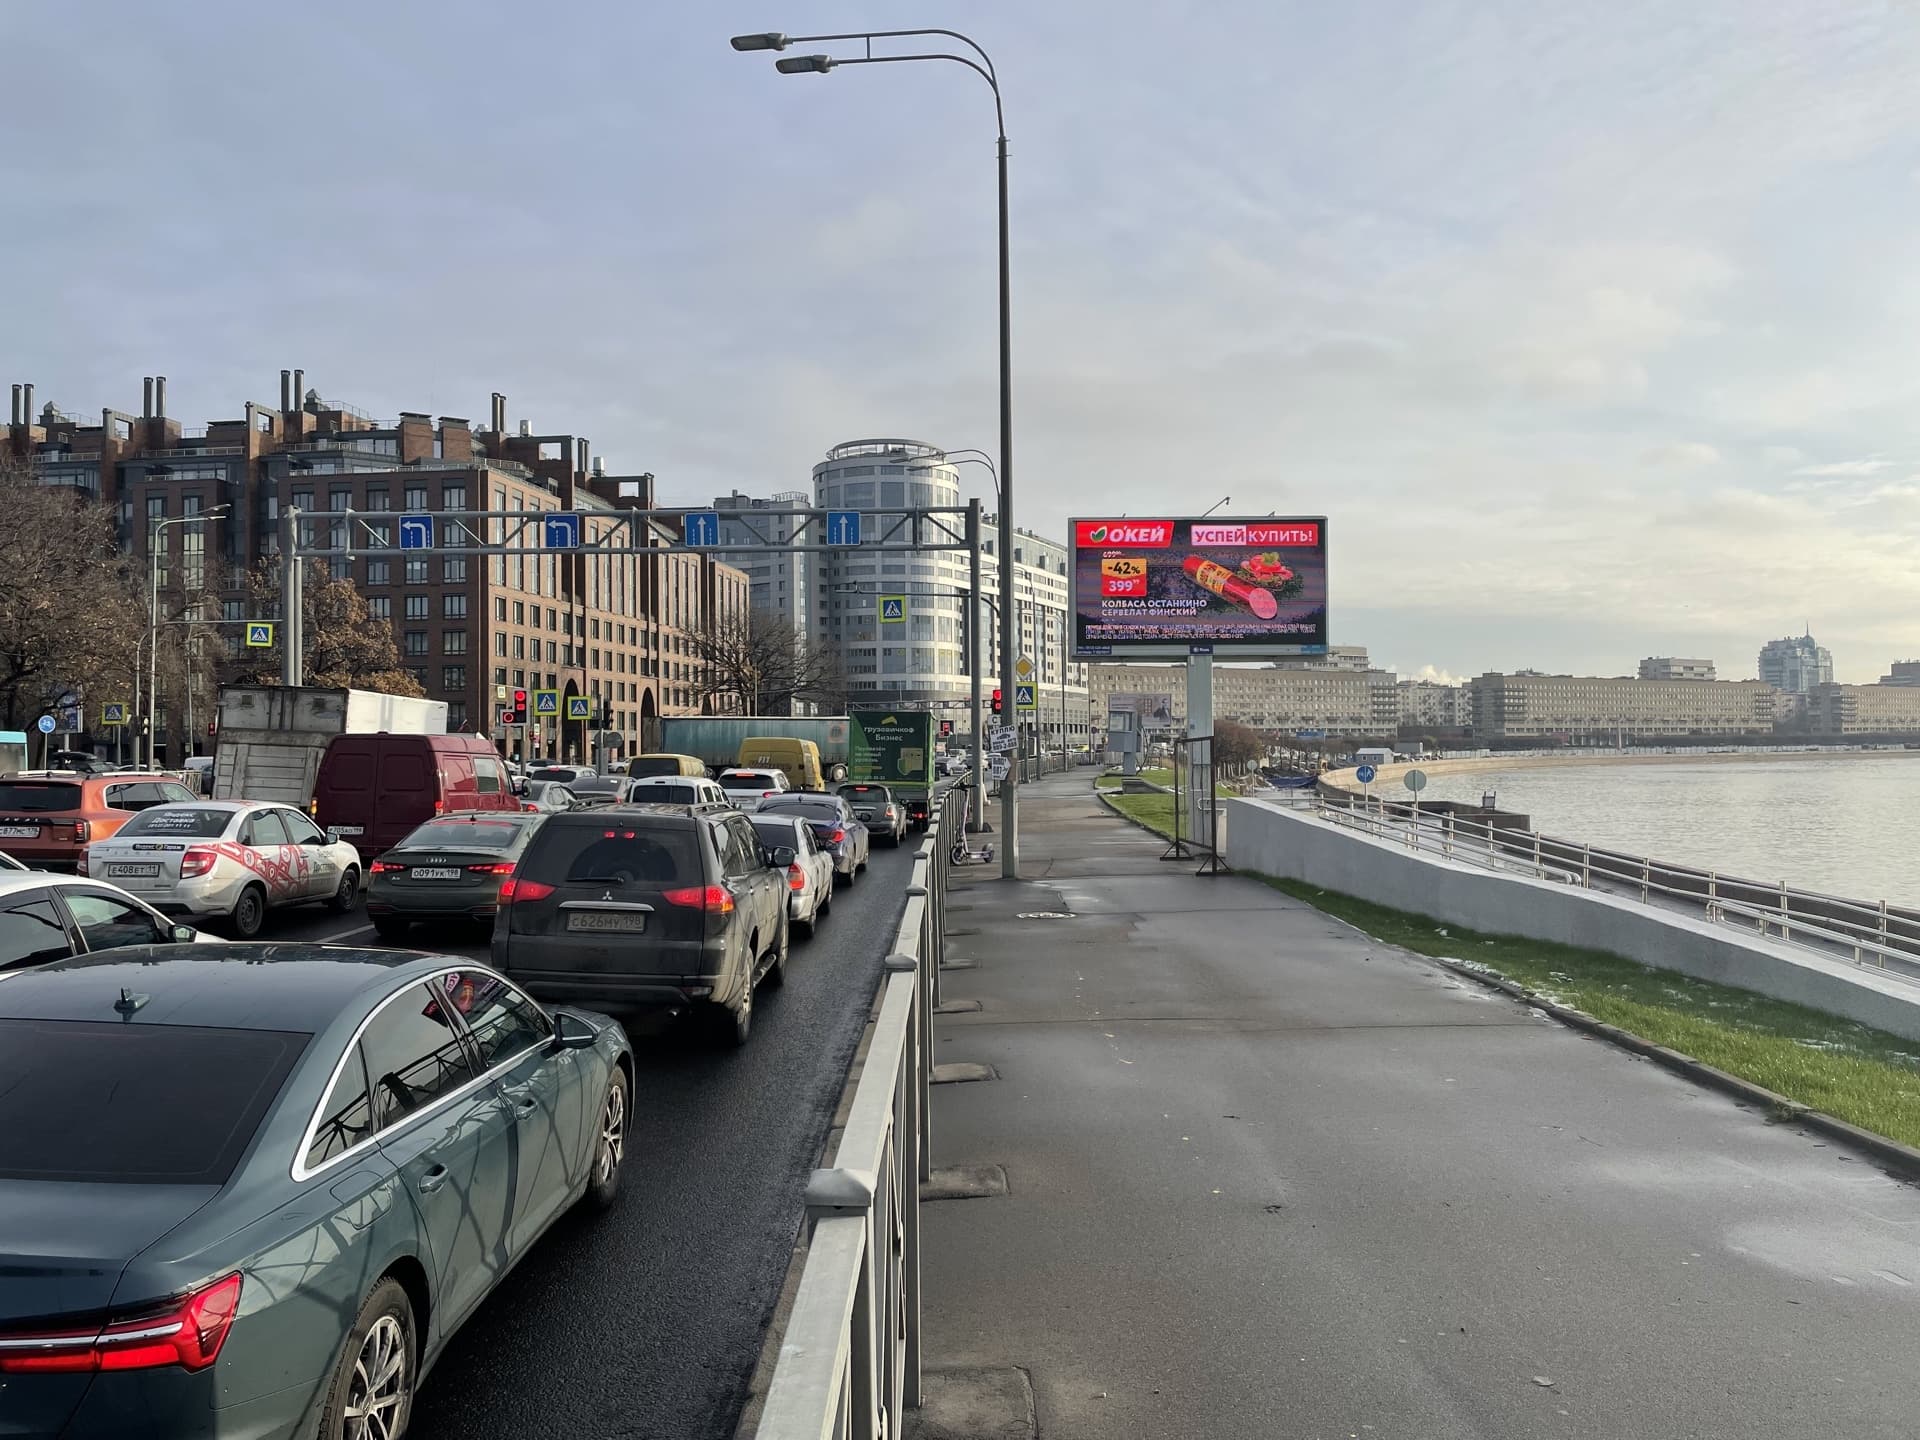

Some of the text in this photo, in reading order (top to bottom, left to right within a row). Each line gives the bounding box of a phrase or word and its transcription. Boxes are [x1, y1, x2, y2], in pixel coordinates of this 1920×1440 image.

[1195, 528, 1313, 543] УСПЕЙ КУПИТЬ!
[1107, 561, 1141, 575] -42%
[1102, 600, 1208, 610] КОЛБАСА ОСТАНКИНО
[1148, 607, 1197, 616] ФИНСКИЙ
[991, 725, 1015, 735] КУПЛЮ
